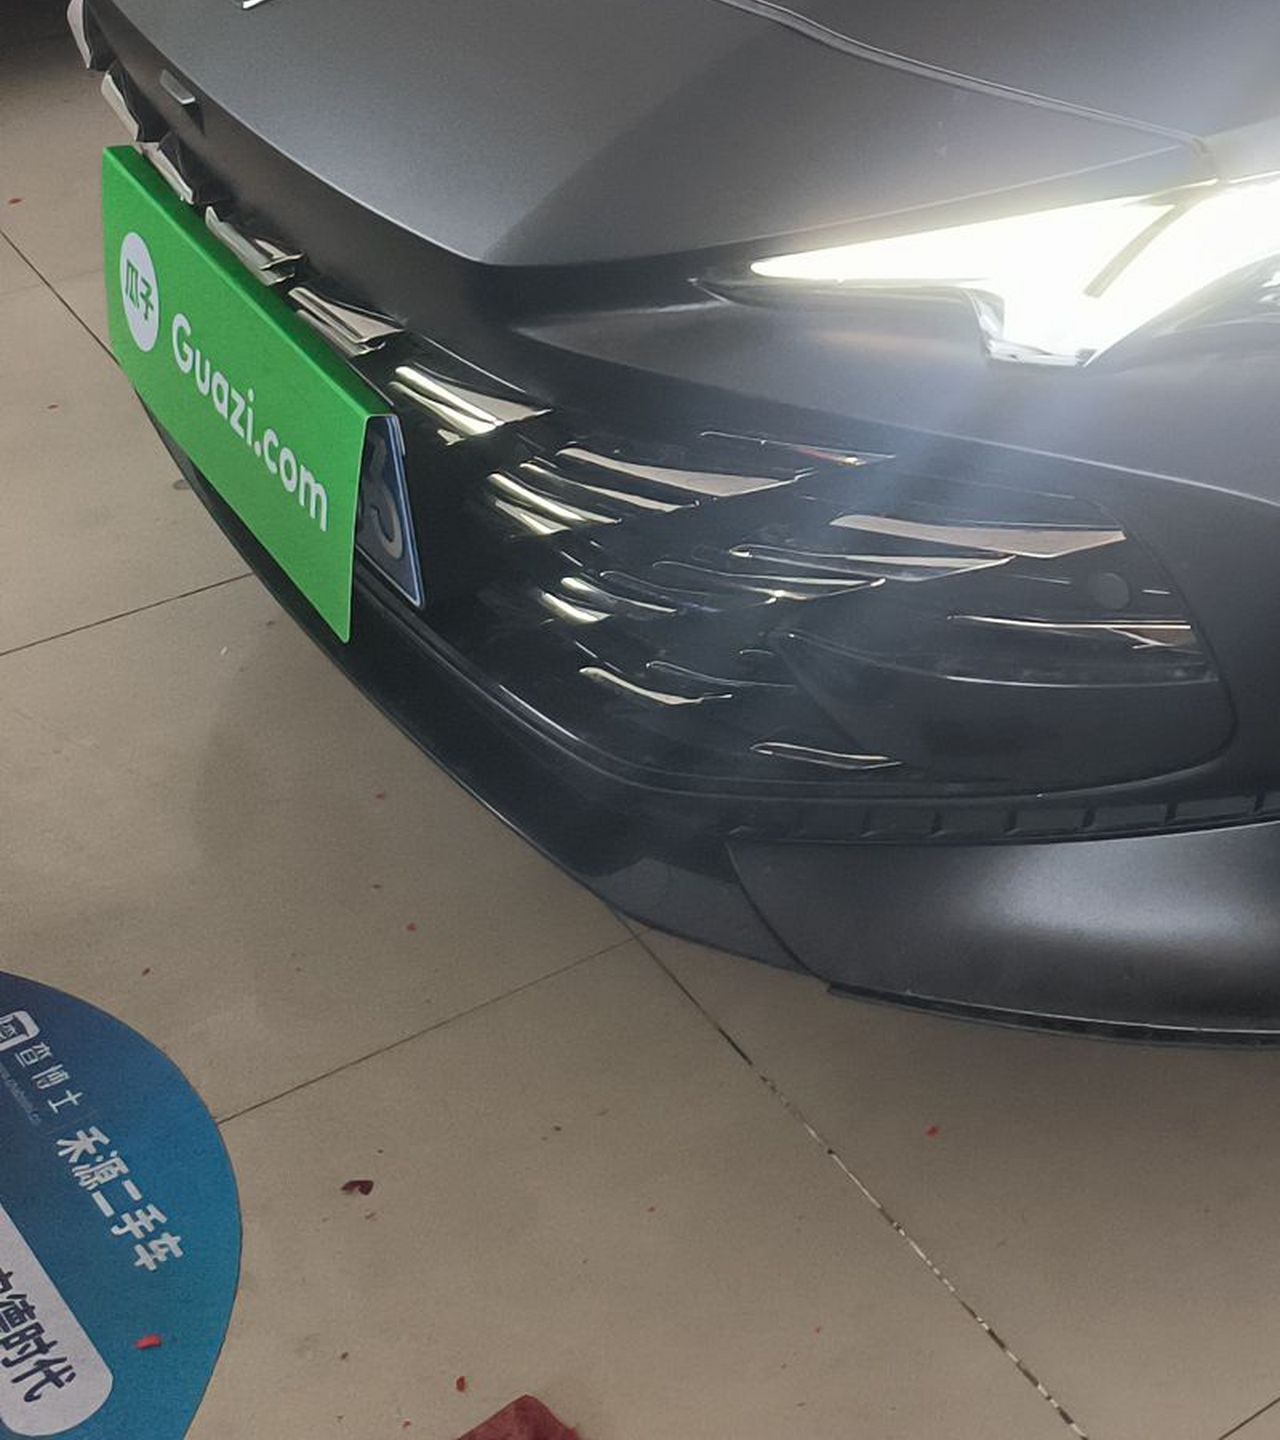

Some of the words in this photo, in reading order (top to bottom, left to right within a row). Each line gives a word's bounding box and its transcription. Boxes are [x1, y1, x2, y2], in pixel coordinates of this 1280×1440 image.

[124, 257, 155, 322] 瓜子
[171, 312, 328, 533] Guazi.com
[14, 1042, 84, 1114] 查博士
[56, 1125, 184, 1272] 禾源二手车
